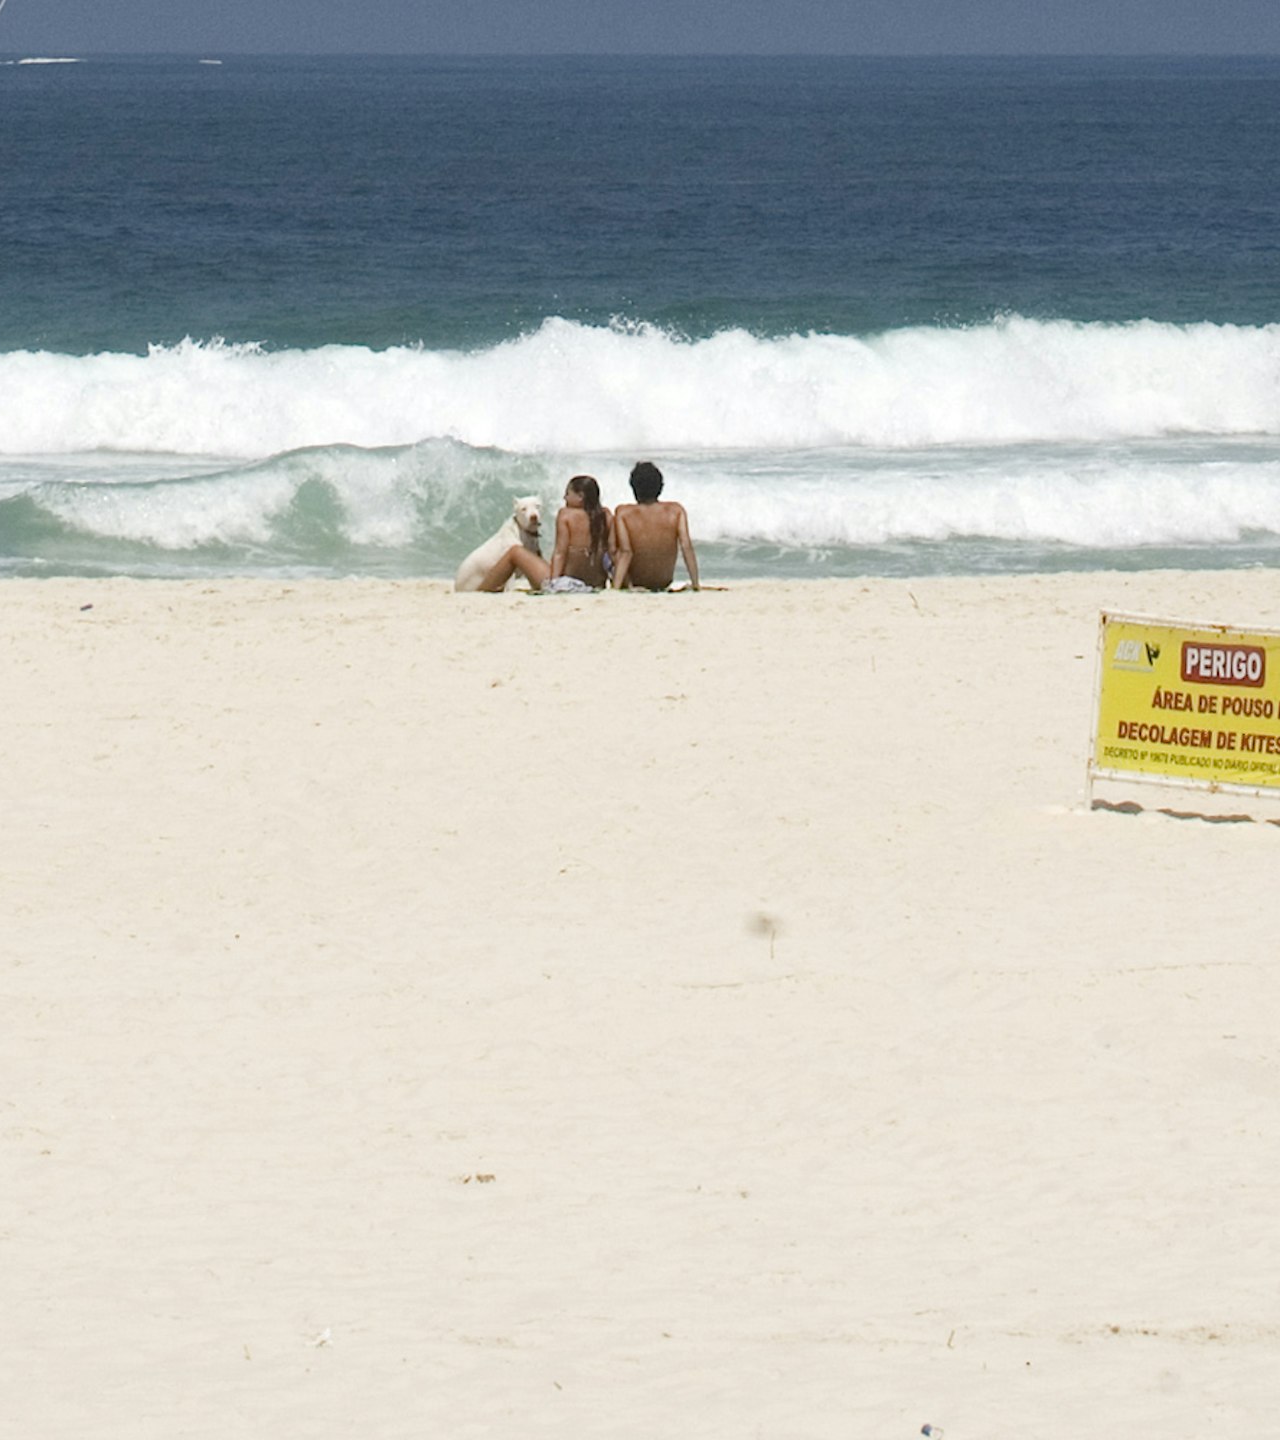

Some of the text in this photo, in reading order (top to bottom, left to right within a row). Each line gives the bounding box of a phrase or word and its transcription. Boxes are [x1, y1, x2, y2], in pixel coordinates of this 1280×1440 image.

[1185, 647, 1262, 681] PERIGO
[1152, 685, 1193, 712] ÁREA
[1198, 694, 1218, 714] DE
[1222, 696, 1273, 718] POUSO
[1118, 720, 1212, 749] DECOLAGEM
[1216, 731, 1236, 750] DE
[1170, 753, 1211, 768] PUBLICADO
